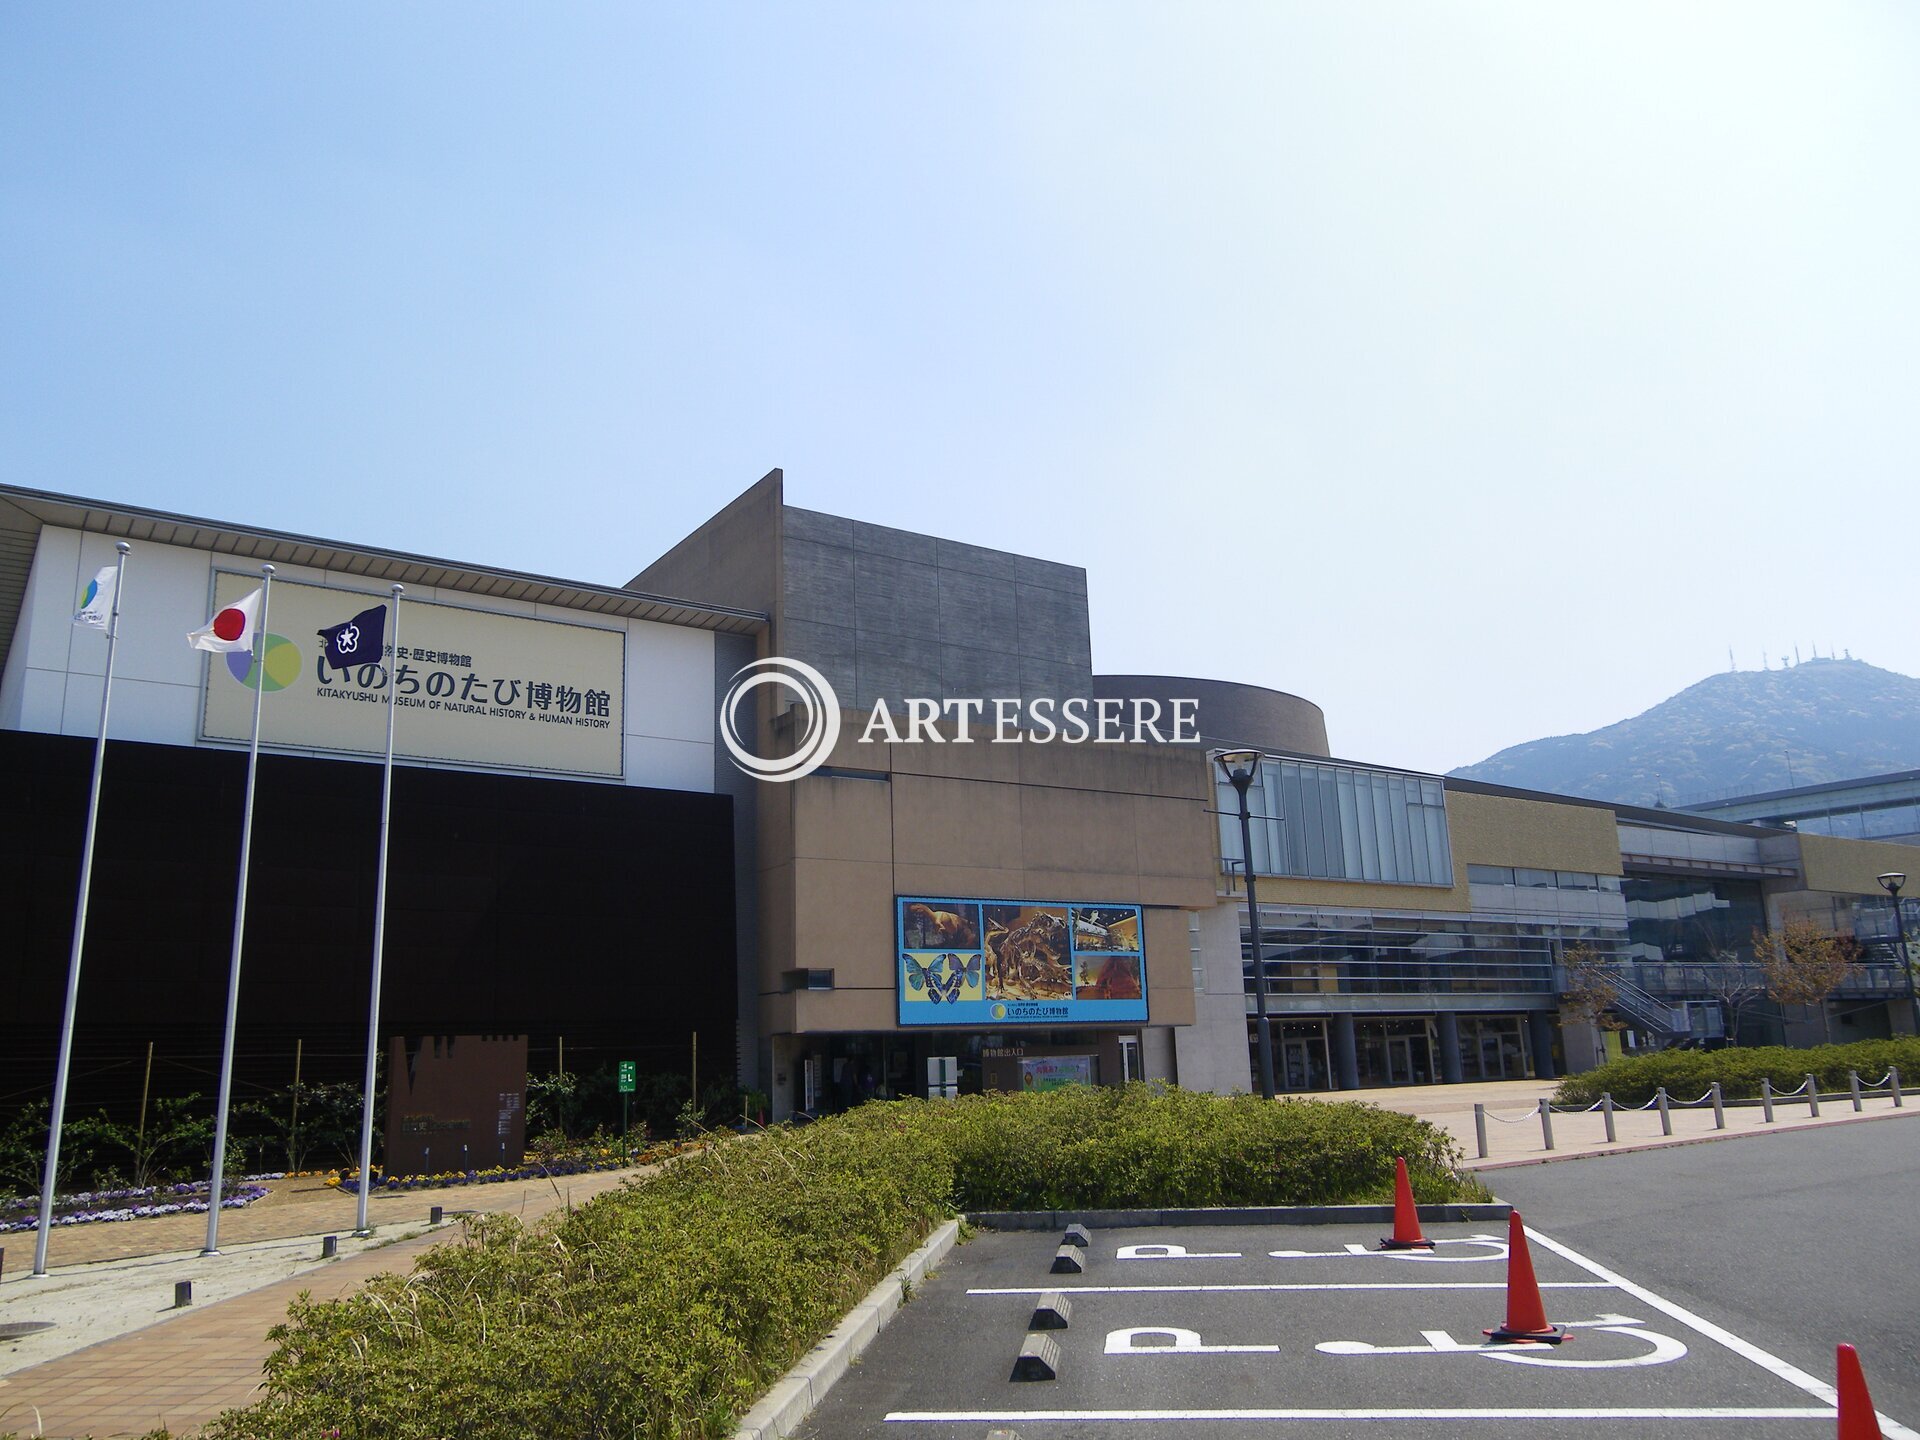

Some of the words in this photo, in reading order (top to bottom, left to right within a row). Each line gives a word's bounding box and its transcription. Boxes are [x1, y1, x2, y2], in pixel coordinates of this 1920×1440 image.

[317, 656, 610, 717] いのちのたび博物館
[317, 687, 378, 703] KITAKYUSHU
[381, 695, 425, 708] MUSEUM
[429, 700, 441, 709] OF
[444, 702, 487, 715] NATURAL
[489, 707, 527, 720] HISTORY
[529, 713, 536, 721] &
[538, 713, 573, 725] HUMAN
[575, 718, 610, 729] HISTORY
